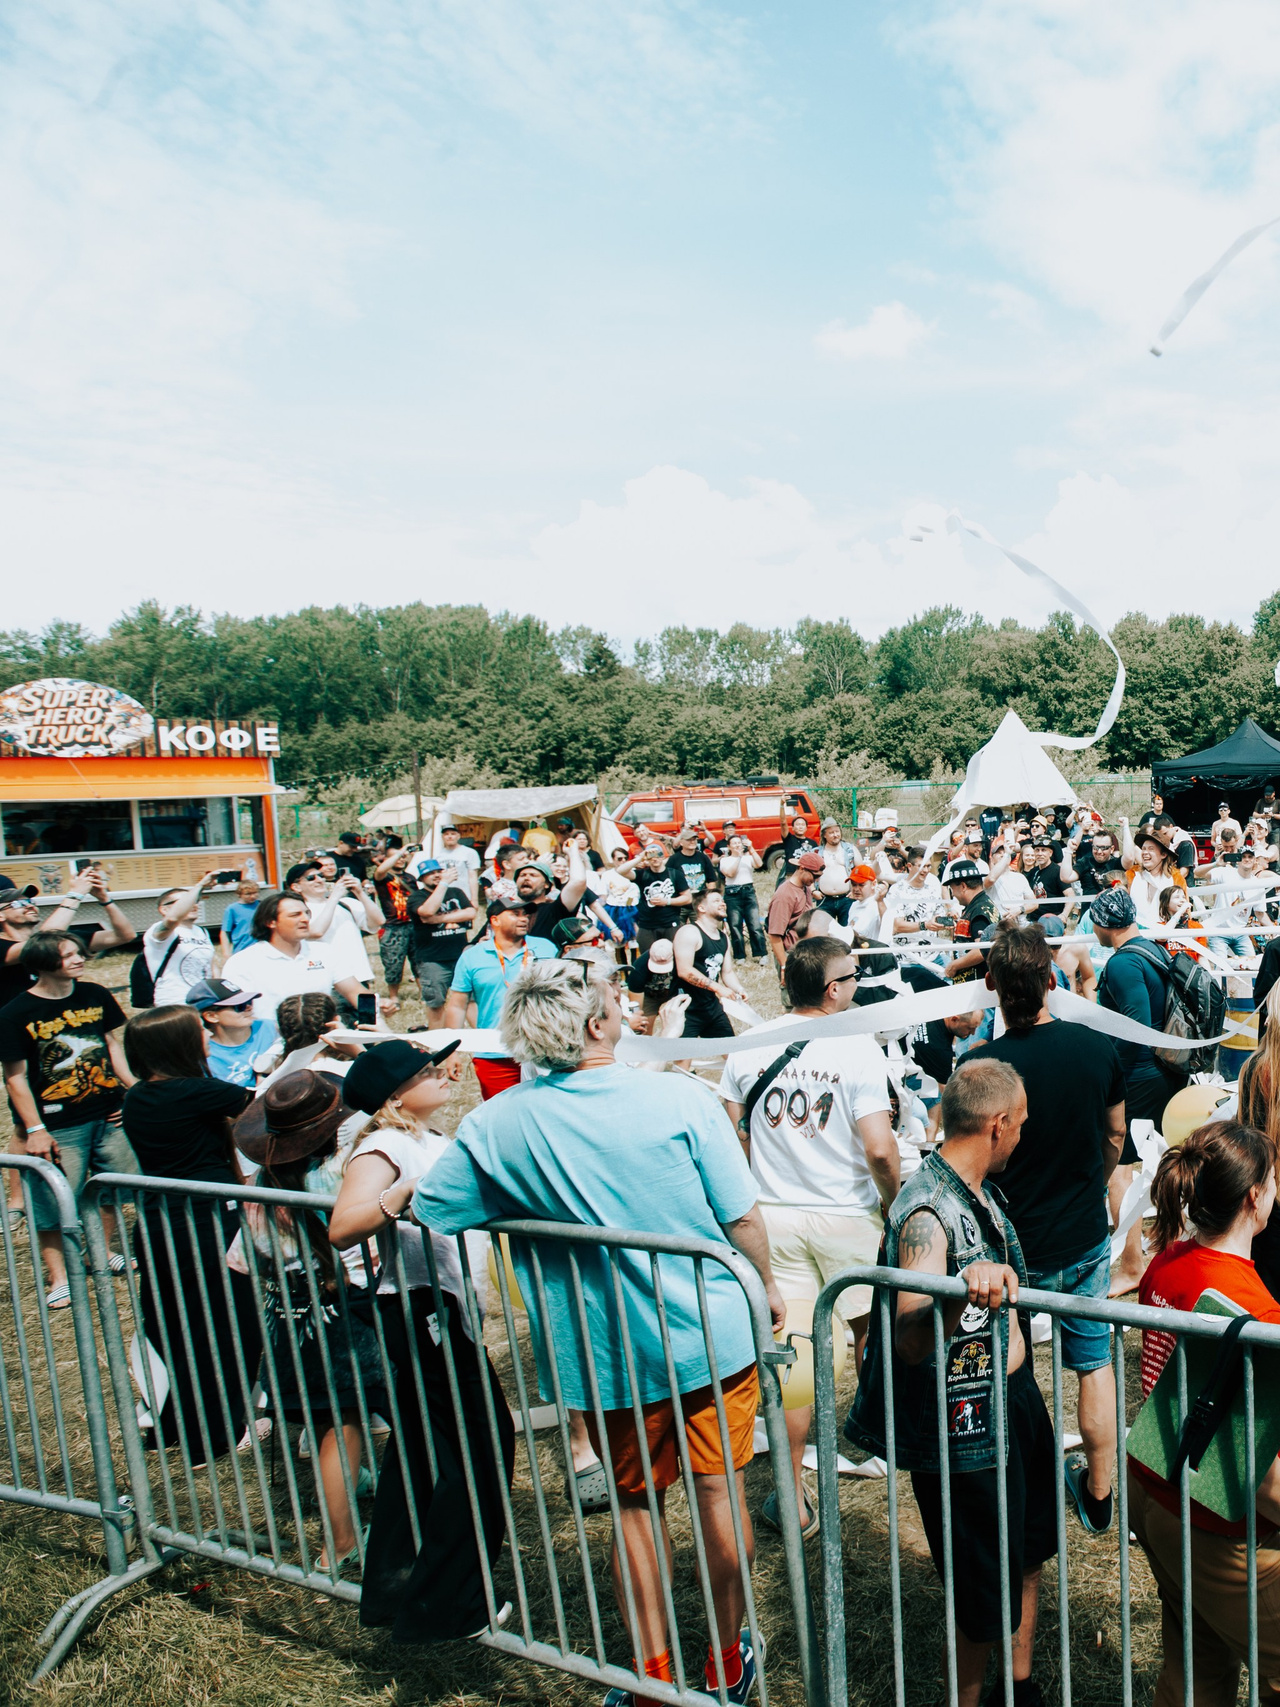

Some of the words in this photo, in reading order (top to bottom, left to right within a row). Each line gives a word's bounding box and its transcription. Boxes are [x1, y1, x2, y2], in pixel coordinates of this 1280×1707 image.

[18, 688, 110, 713] SUPER
[34, 707, 104, 726] HERO
[27, 723, 115, 748] TRUCK
[159, 726, 280, 751] КОФЕ
[764, 1086, 834, 1132] 001
